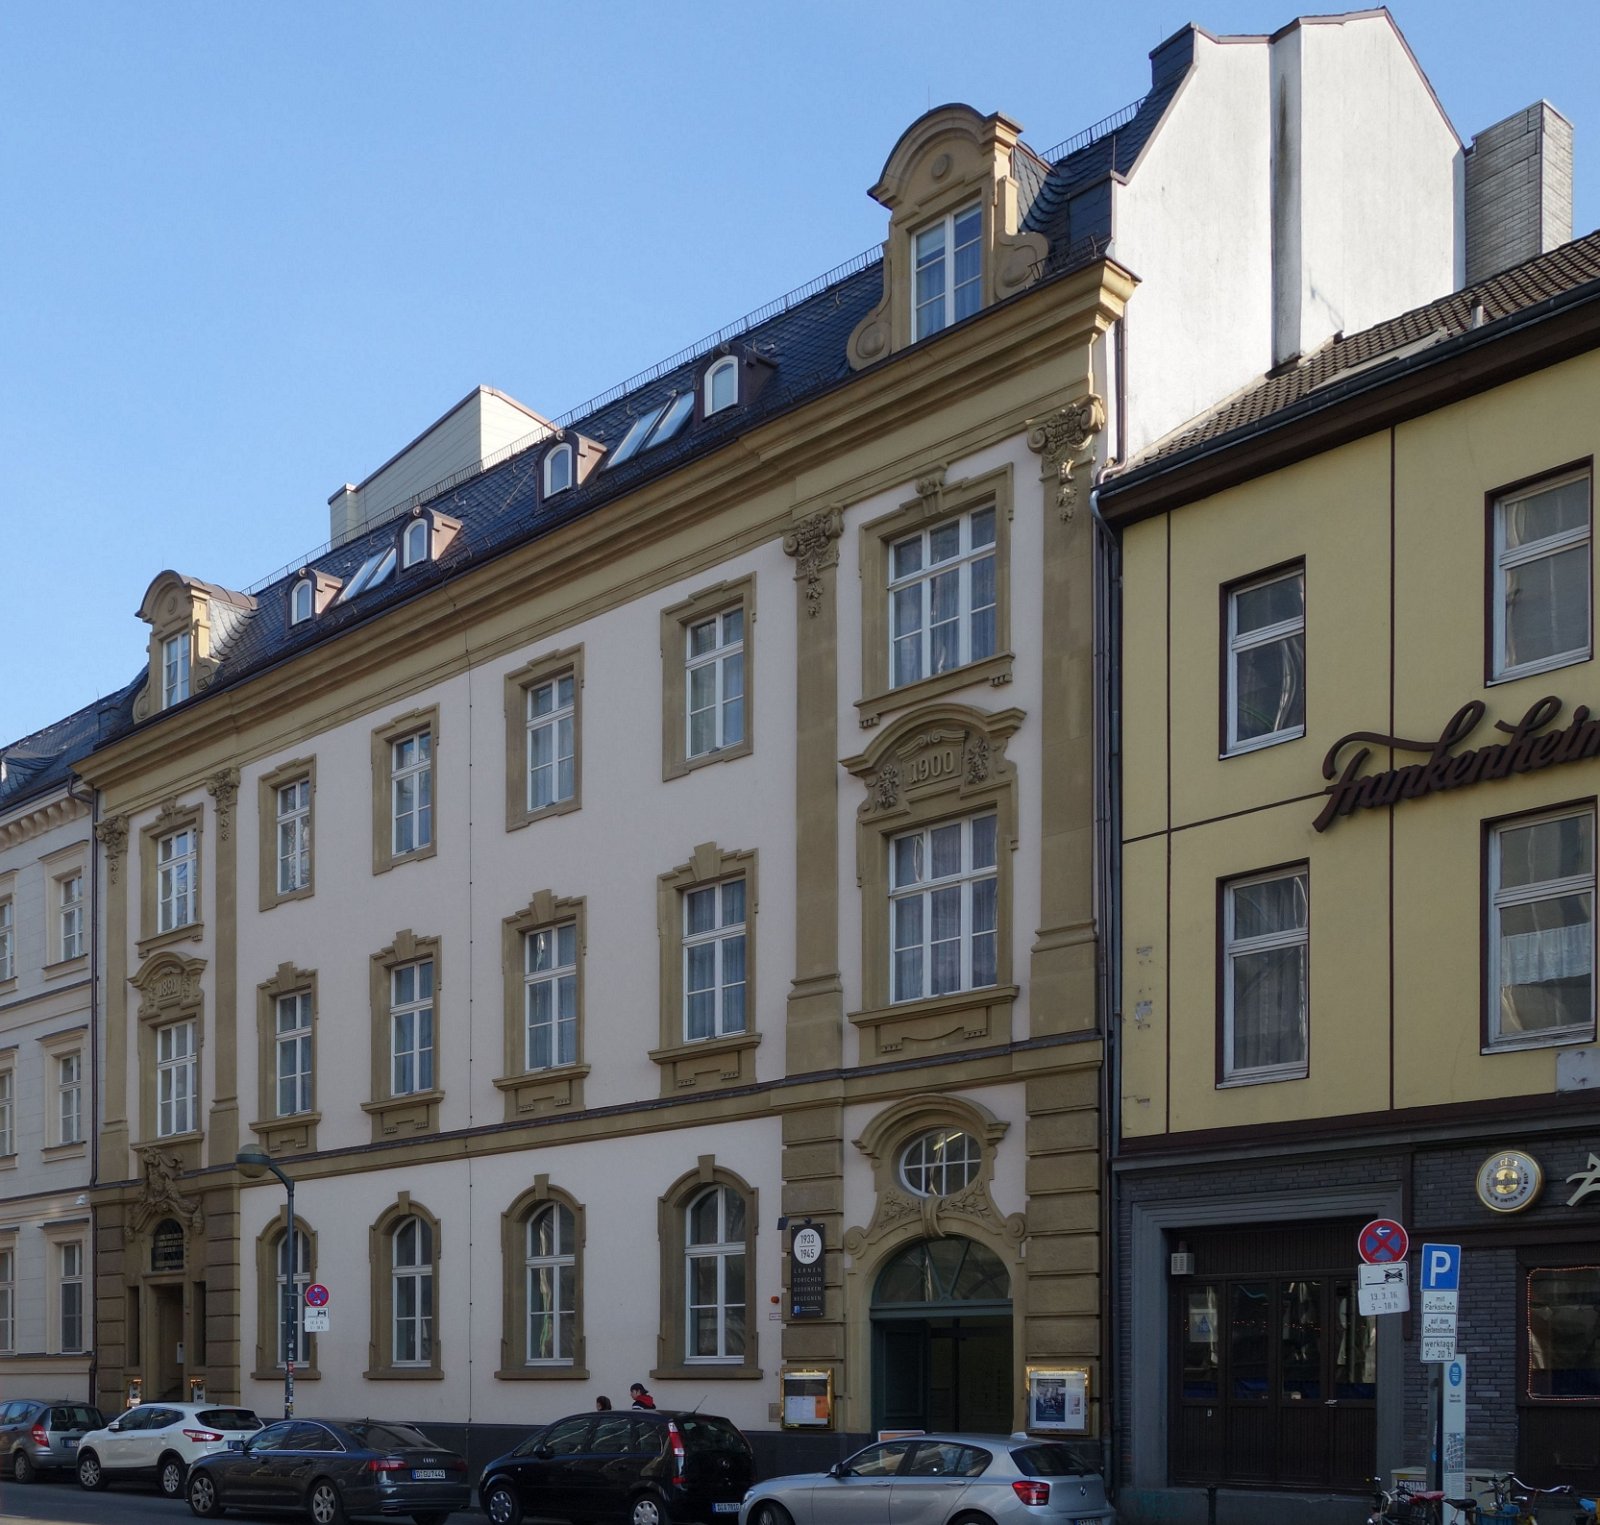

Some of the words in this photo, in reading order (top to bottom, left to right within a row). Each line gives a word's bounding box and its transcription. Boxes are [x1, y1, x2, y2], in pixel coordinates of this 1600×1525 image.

[908, 750, 954, 784] 1900
[800, 1234, 815, 1245] 1933
[800, 1248, 815, 1259] 1945
[1429, 1250, 1451, 1287] P
[1424, 1303, 1456, 1311] Parkschein
[1430, 1316, 1438, 1324] auf
[1424, 1340, 1454, 1350] werktags
[1437, 1350, 1446, 1358] 20
